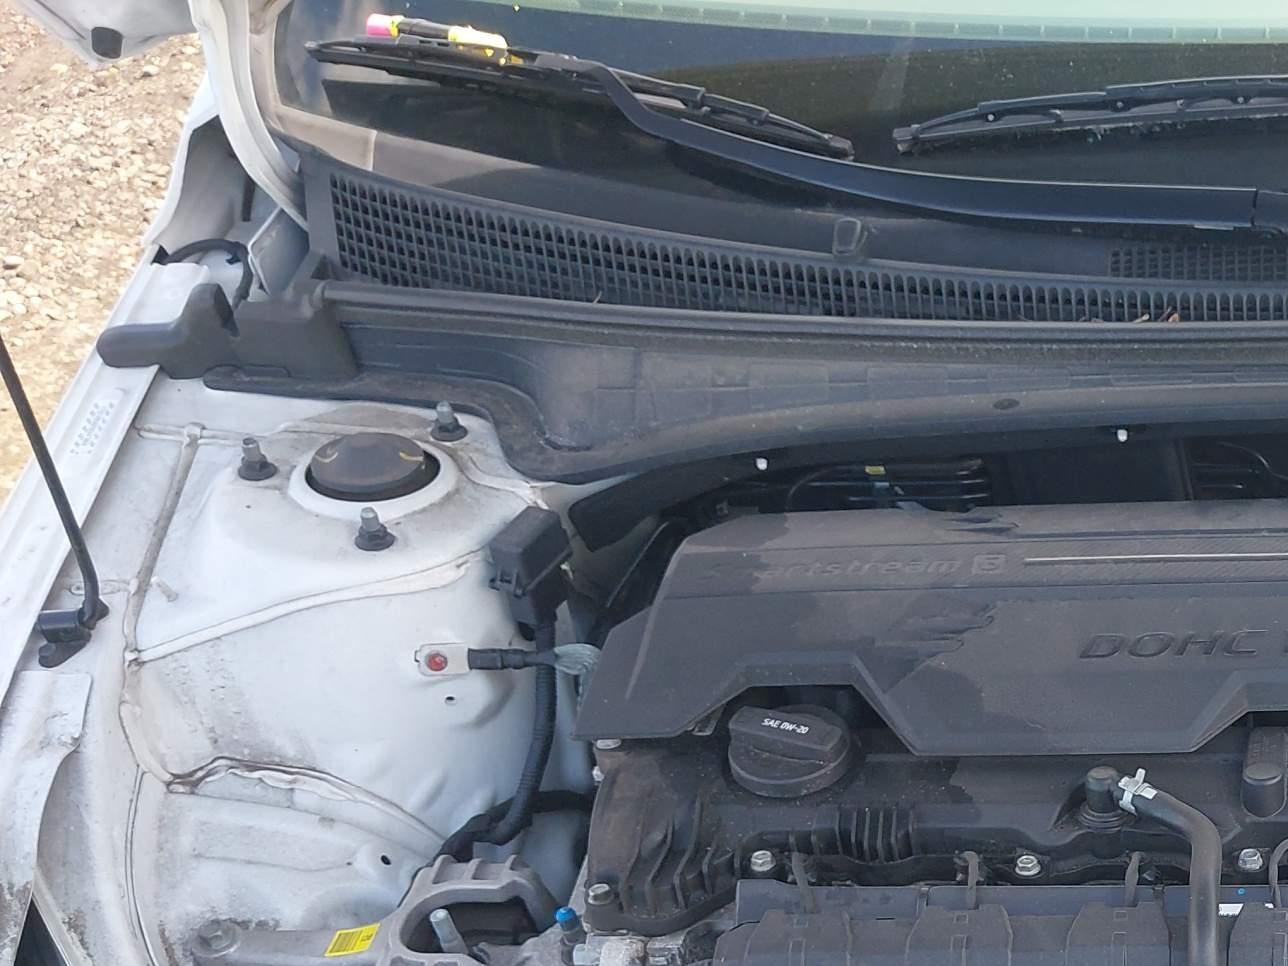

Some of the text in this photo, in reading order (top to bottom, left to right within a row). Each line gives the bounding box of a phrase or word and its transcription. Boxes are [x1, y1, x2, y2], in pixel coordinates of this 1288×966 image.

[1079, 630, 1268, 659] DOHC
[761, 718, 810, 734] SAE 0W-20
